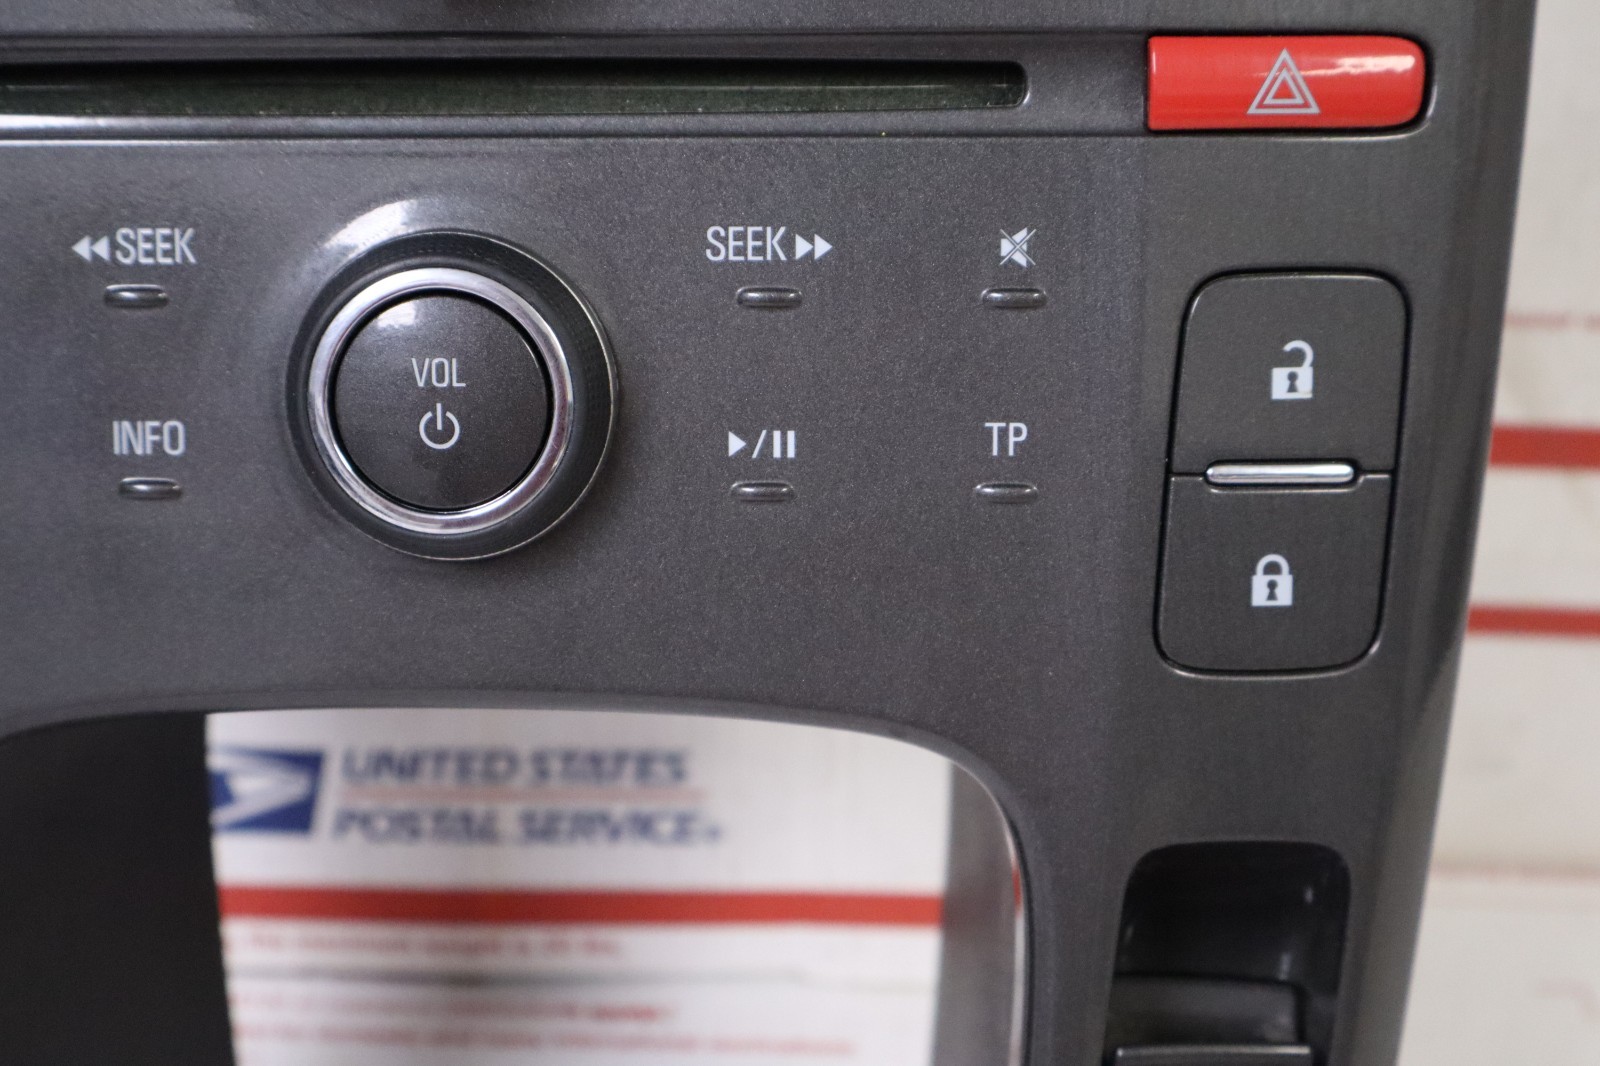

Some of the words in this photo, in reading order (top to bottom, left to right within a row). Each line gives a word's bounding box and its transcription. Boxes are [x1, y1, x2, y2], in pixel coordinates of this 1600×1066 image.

[115, 227, 197, 265] SEEK
[705, 226, 788, 262] SEEK
[411, 357, 467, 388] VOL
[112, 420, 187, 456] INFO
[984, 422, 1028, 456] TP
[341, 746, 519, 783] UNITED
[524, 748, 688, 787] STATES
[332, 808, 503, 843] POSTAL
